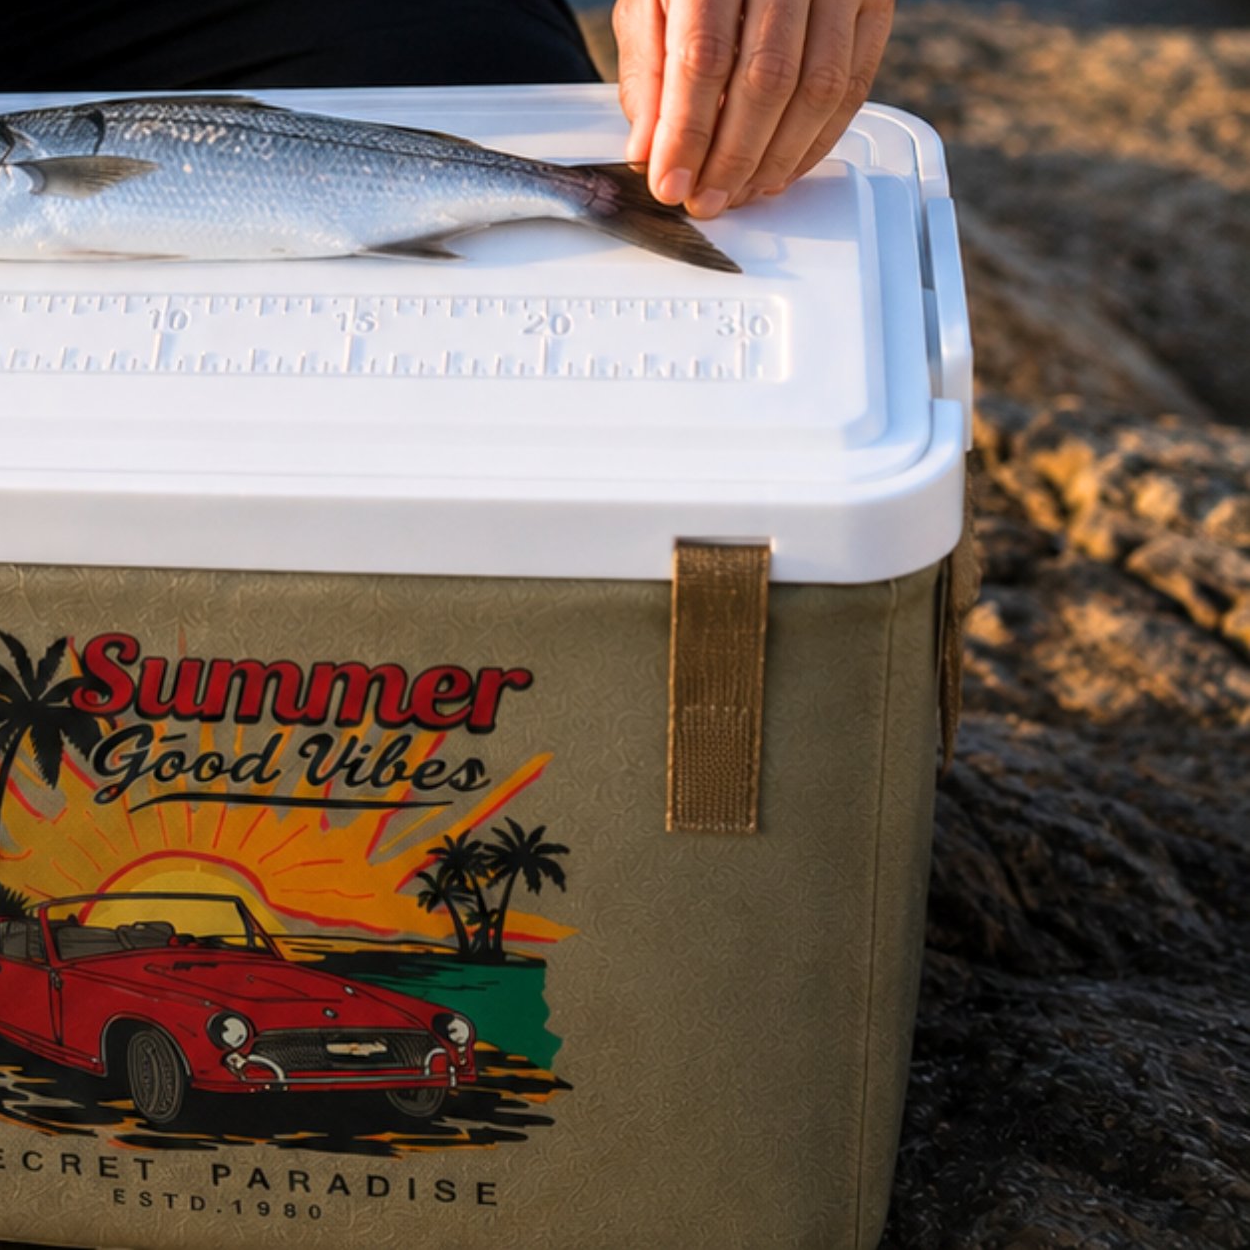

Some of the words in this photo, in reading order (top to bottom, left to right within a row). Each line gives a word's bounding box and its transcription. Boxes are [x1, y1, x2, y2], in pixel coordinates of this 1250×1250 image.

[149, 308, 191, 331] 10
[336, 311, 380, 334] 15
[520, 311, 573, 336] 20
[715, 313, 774, 337] 30
[70, 631, 534, 734] Summer
[92, 723, 286, 805] Good
[297, 732, 492, 792] Vibes
[211, 1162, 499, 1207] PARADISE
